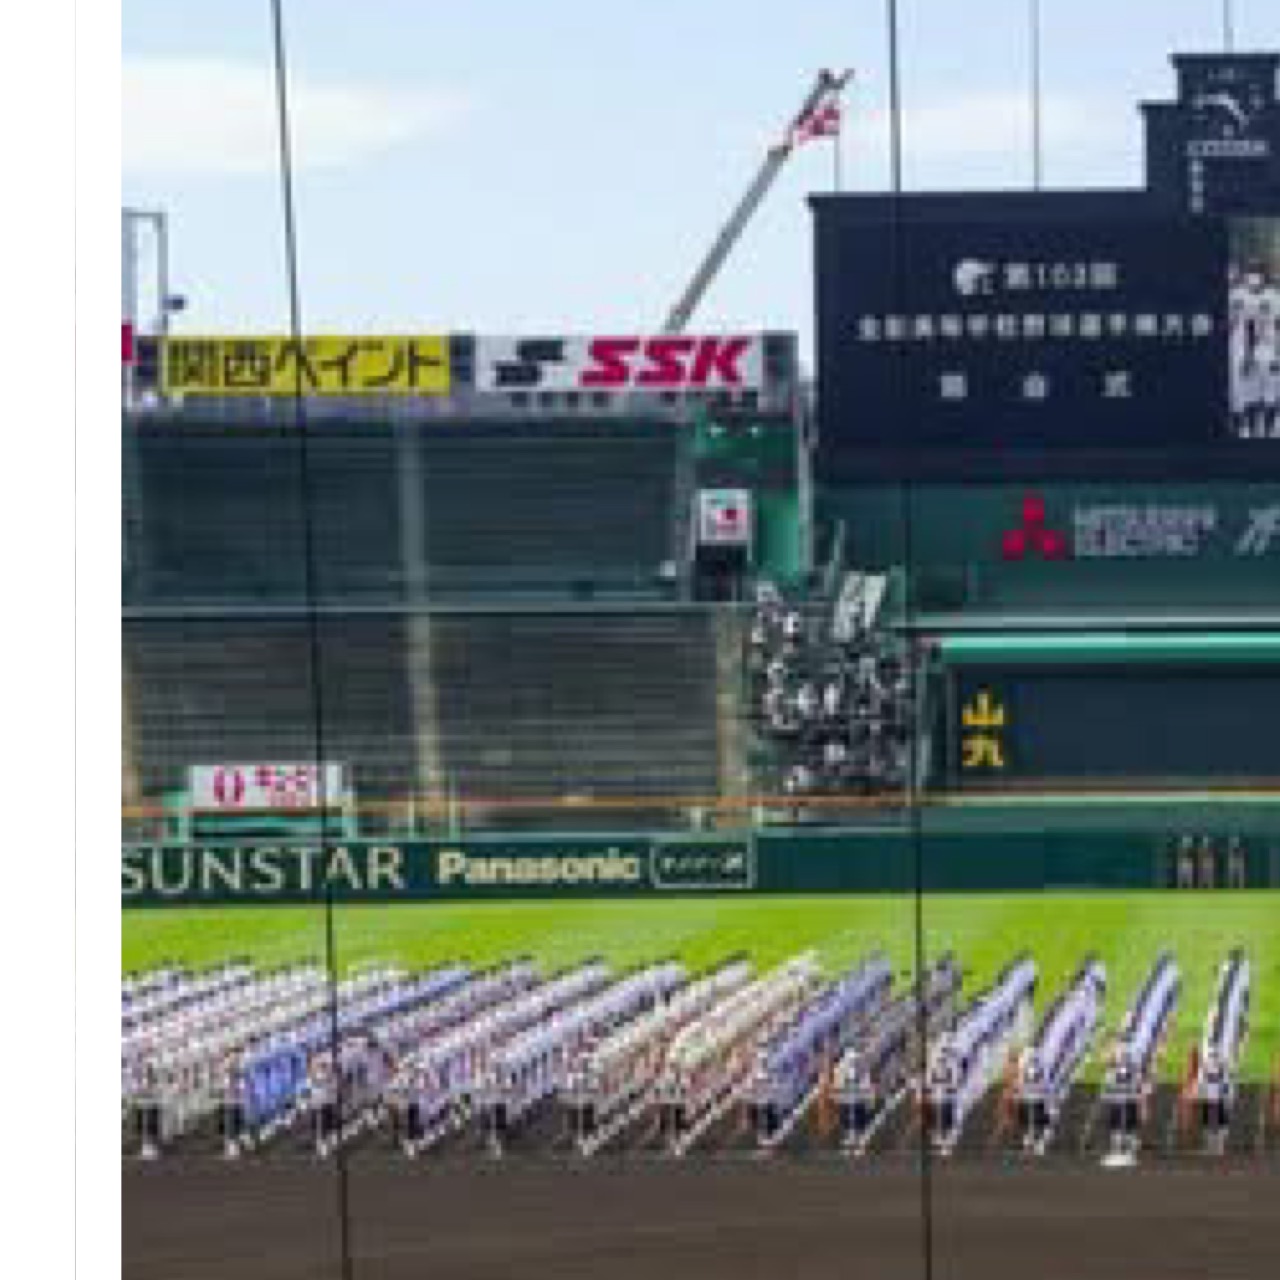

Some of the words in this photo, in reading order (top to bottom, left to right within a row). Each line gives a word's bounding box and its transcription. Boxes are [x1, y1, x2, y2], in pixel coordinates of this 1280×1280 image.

[578, 337, 751, 387] SSK
[122, 845, 406, 894] SUNSTAR
[438, 847, 641, 885] Panasonic
